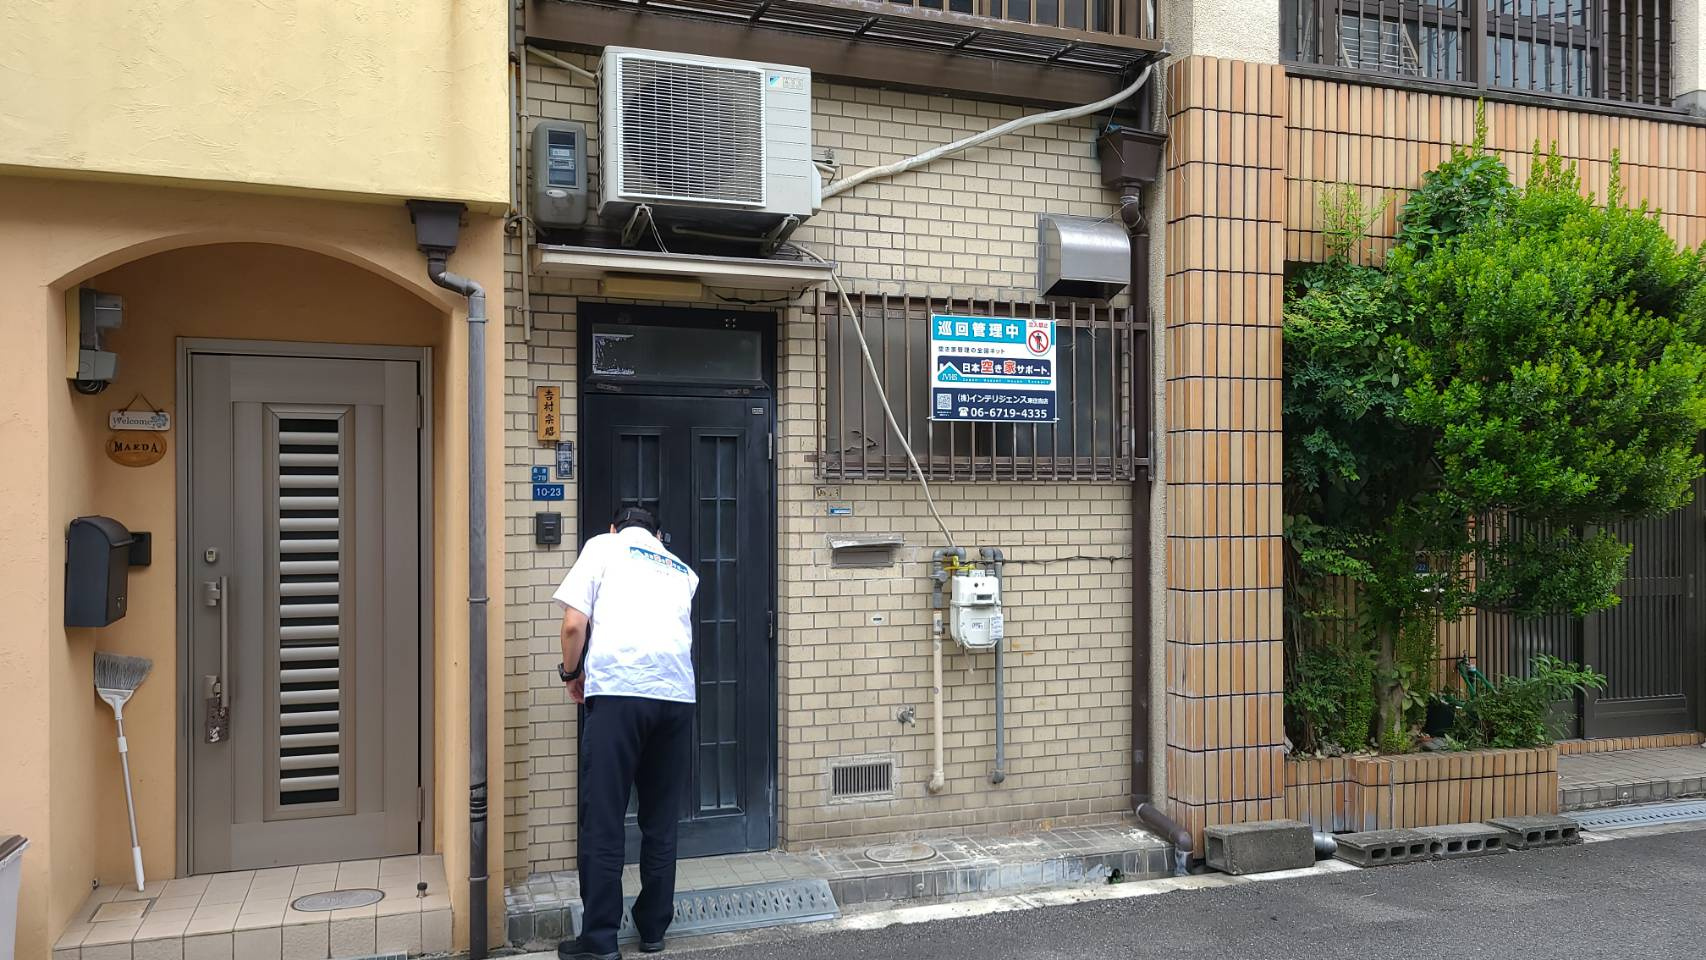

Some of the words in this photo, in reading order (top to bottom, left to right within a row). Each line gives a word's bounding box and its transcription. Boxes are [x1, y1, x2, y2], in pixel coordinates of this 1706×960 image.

[938, 321, 1019, 338] 巡回管理中
[970, 407, 1048, 419] 06-6719-4335
[112, 416, 153, 426] Welcome
[536, 488, 561, 497] 10-23
